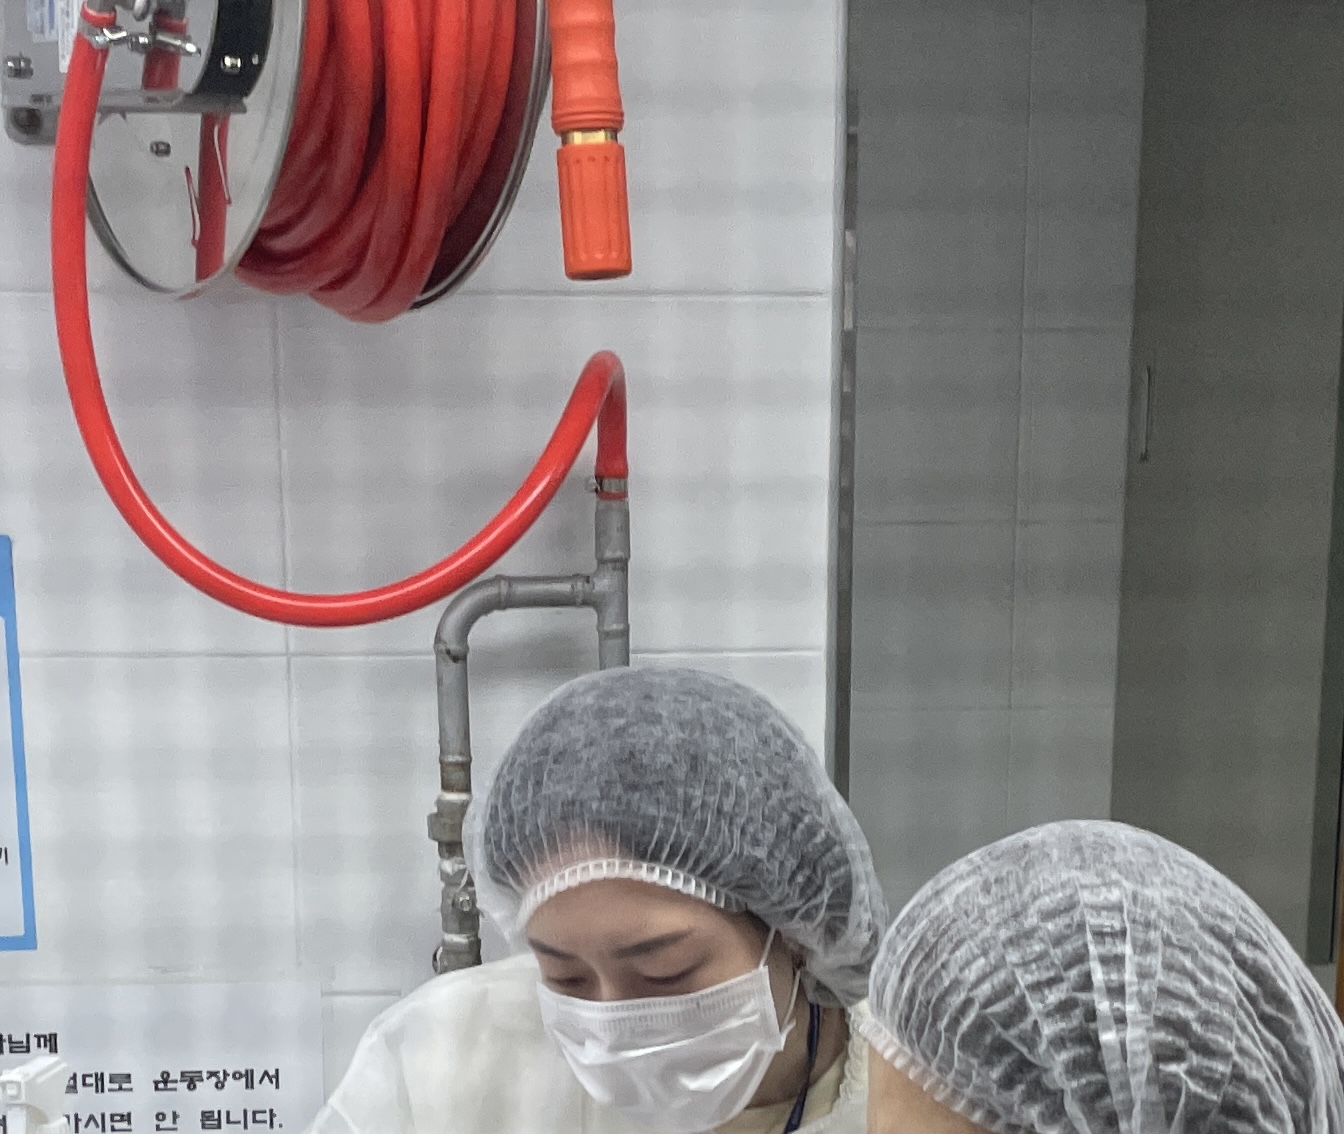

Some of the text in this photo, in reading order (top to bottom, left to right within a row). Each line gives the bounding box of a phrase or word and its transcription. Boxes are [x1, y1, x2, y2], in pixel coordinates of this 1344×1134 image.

[153, 1068, 280, 1092] 운동장에서
[155, 1109, 181, 1132] 안
[200, 1108, 283, 1131] 됩니다.
